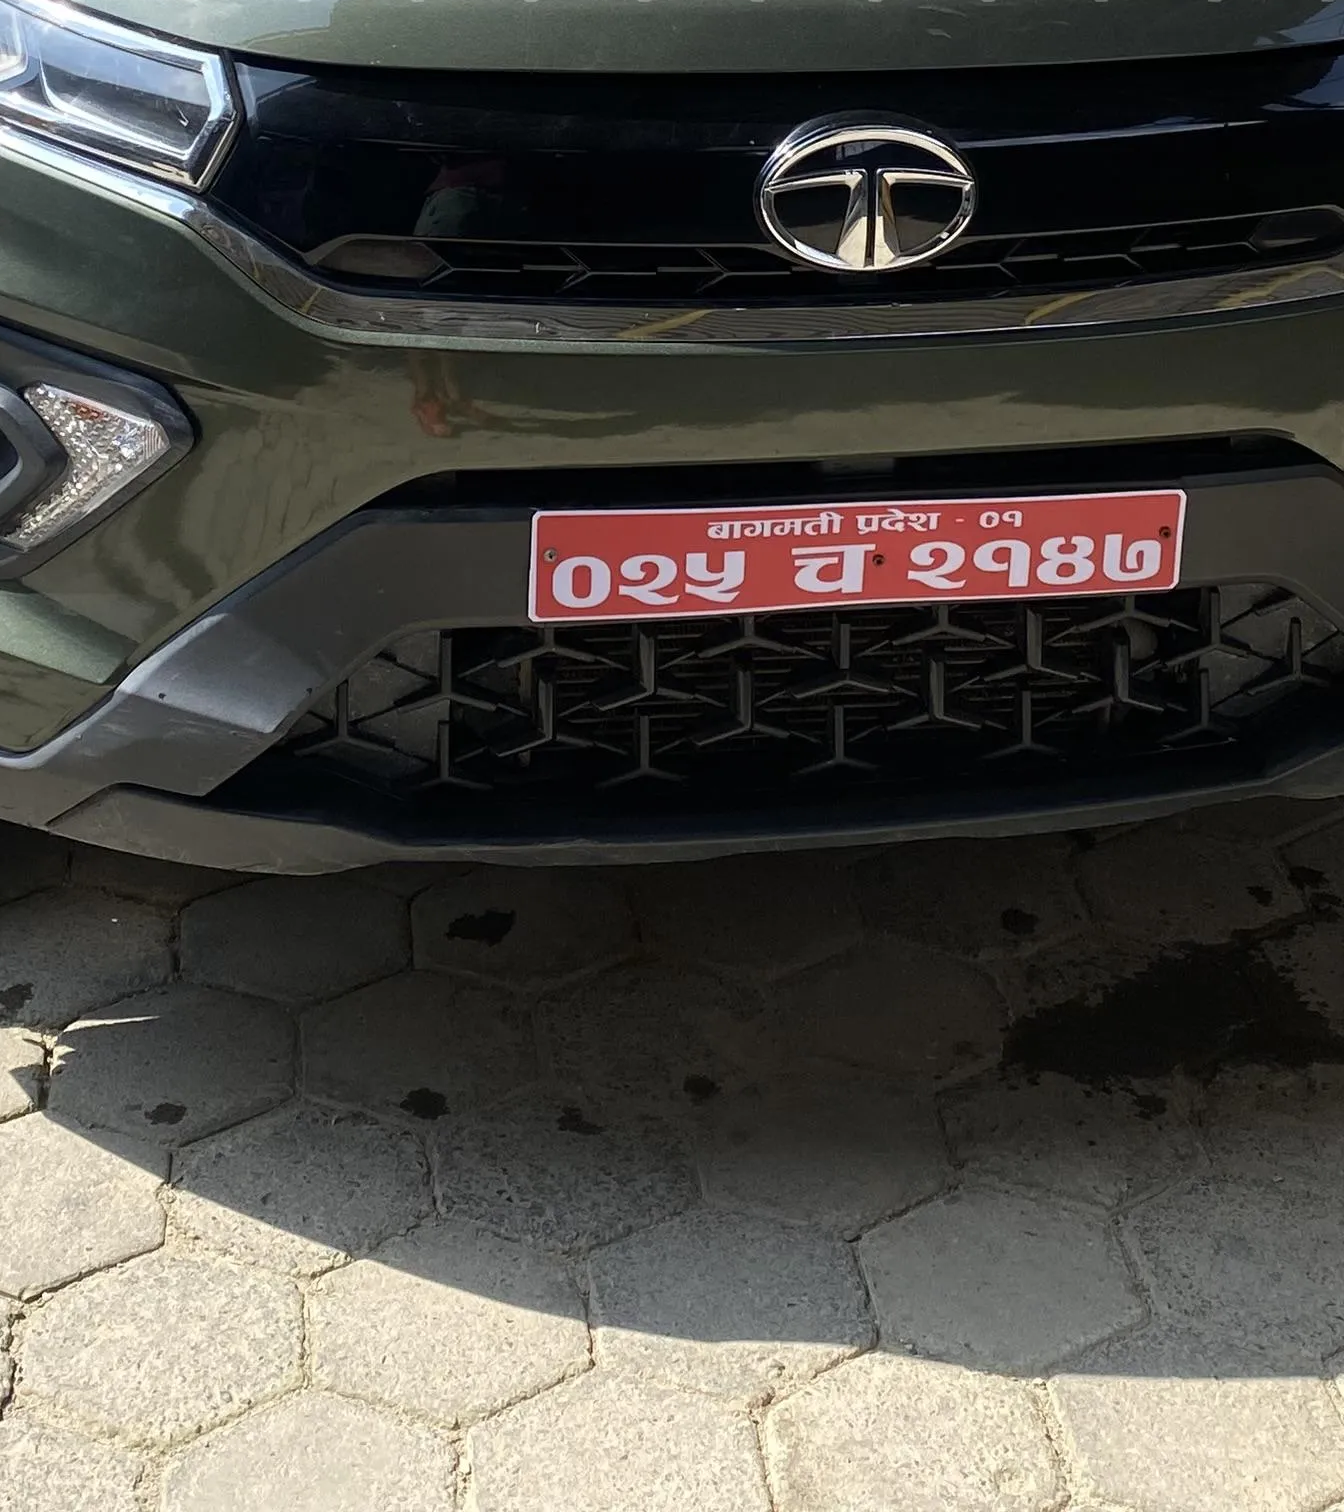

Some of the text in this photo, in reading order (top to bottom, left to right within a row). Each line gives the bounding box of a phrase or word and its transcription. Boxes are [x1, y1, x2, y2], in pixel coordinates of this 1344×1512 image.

[707, 512, 843, 541] बागमती
[855, 508, 941, 534] प्रदेश
[978, 510, 1023, 529] ०१
[552, 533, 1162, 609] ०२५ च २१४७
